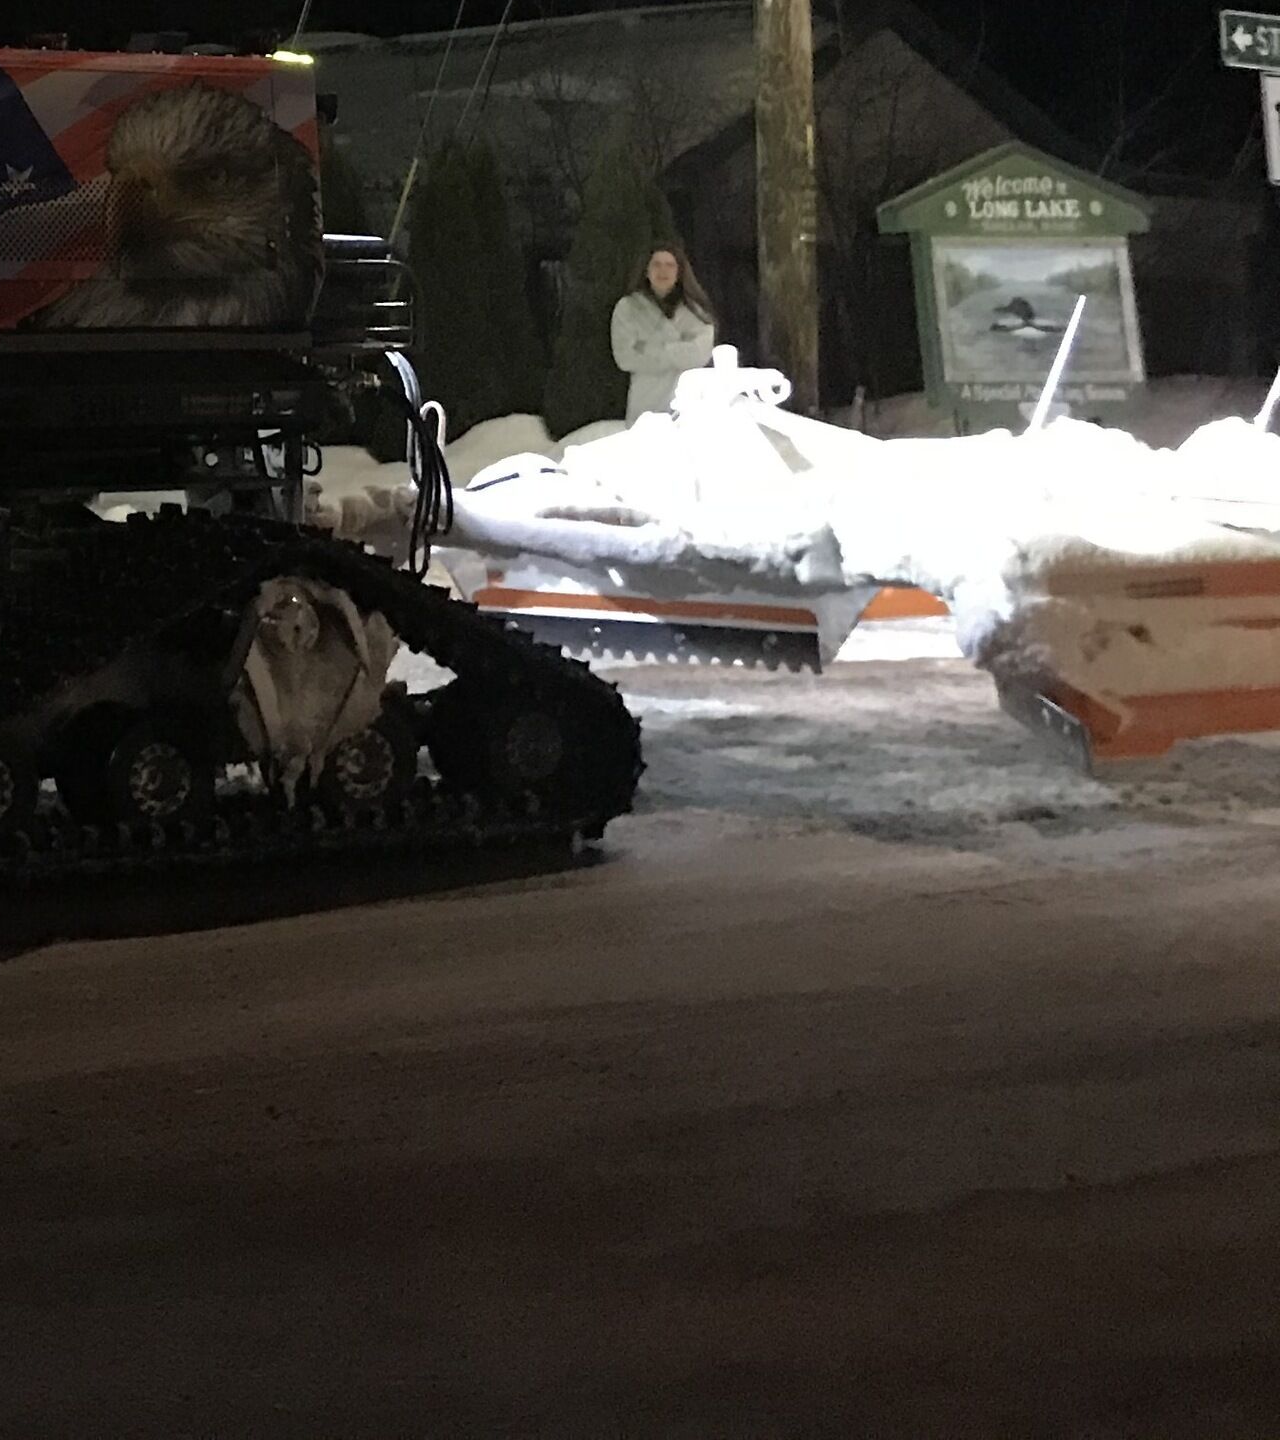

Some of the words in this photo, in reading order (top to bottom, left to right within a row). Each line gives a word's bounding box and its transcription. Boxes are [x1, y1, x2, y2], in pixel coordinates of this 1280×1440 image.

[962, 175, 1053, 202] Welcome
[970, 200, 1020, 219] LONG
[1024, 198, 1081, 219] LAKE
